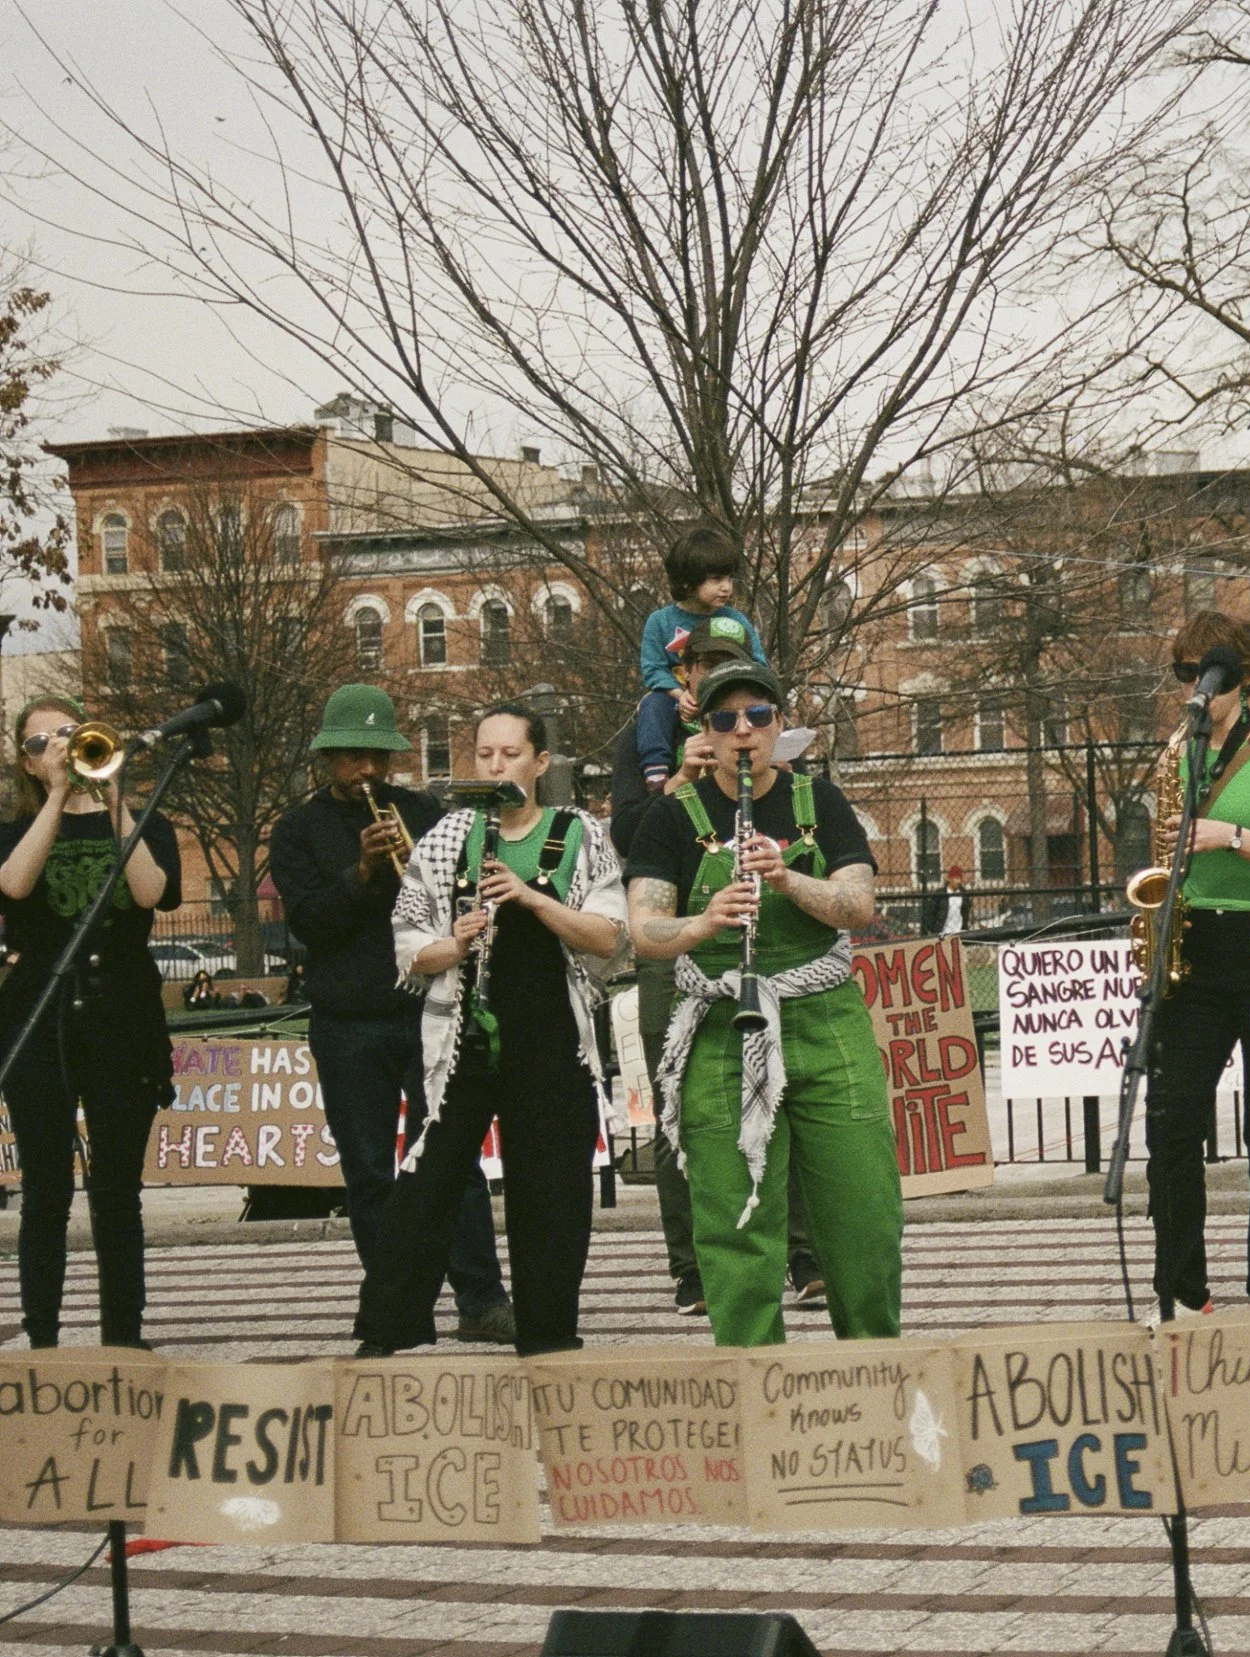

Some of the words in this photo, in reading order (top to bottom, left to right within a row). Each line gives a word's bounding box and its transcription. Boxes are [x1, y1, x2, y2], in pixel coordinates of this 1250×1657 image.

[851, 937, 965, 1013] OMEN
[1001, 949, 1084, 981] QUIERO
[1090, 950, 1119, 974] UN
[1006, 979, 1096, 1009] SANGRE
[886, 1007, 938, 1036] THE
[1013, 1008, 1083, 1035] NUNCA
[171, 1046, 241, 1077] ATE
[250, 1047, 310, 1075] HAS
[879, 1035, 978, 1090] RLD
[1012, 1044, 1038, 1069] DE
[1048, 1041, 1093, 1065] SUS
[172, 1083, 242, 1113] LACE
[250, 1082, 282, 1112] IN
[157, 1123, 341, 1170] HEARTS
[592, 1376, 736, 1411] COMUNIDAD
[763, 1362, 912, 1421] Community
[966, 1347, 1161, 1441] ABOLISH
[341, 1372, 532, 1450] ABOLISH
[69, 1417, 125, 1451] for
[168, 1398, 334, 1486] RESIST
[544, 1424, 592, 1455] TE
[552, 1455, 688, 1490] NOSOTROS
[704, 1456, 743, 1482] NOS
[771, 1450, 800, 1480] NO
[1012, 1433, 1153, 1515] ICE
[25, 1456, 148, 1512] ALL
[375, 1446, 501, 1527] ICE
